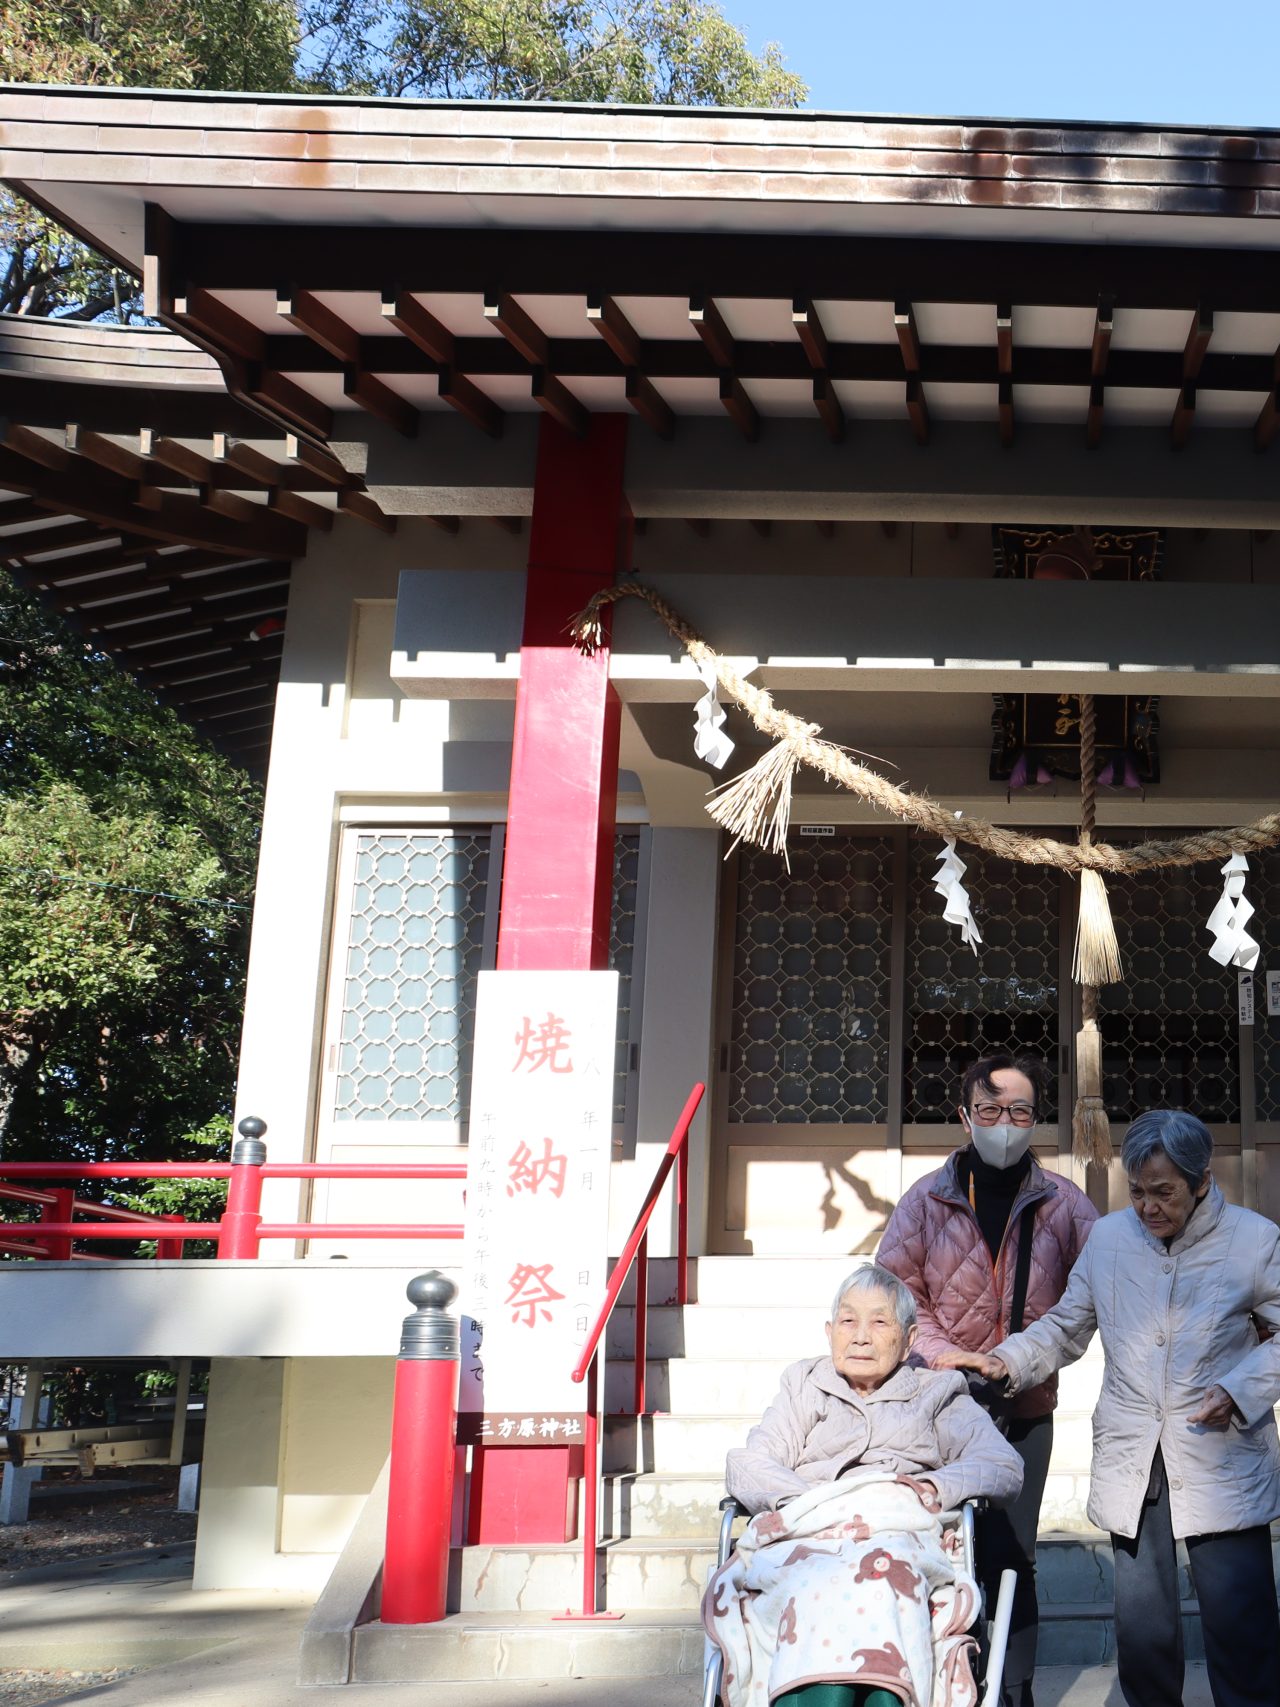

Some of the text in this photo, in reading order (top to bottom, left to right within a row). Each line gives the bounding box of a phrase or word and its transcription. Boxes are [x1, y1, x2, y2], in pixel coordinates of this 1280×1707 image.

[505, 1011, 574, 1330] 焼納祭
[475, 1417, 582, 1440] 三方原神社
